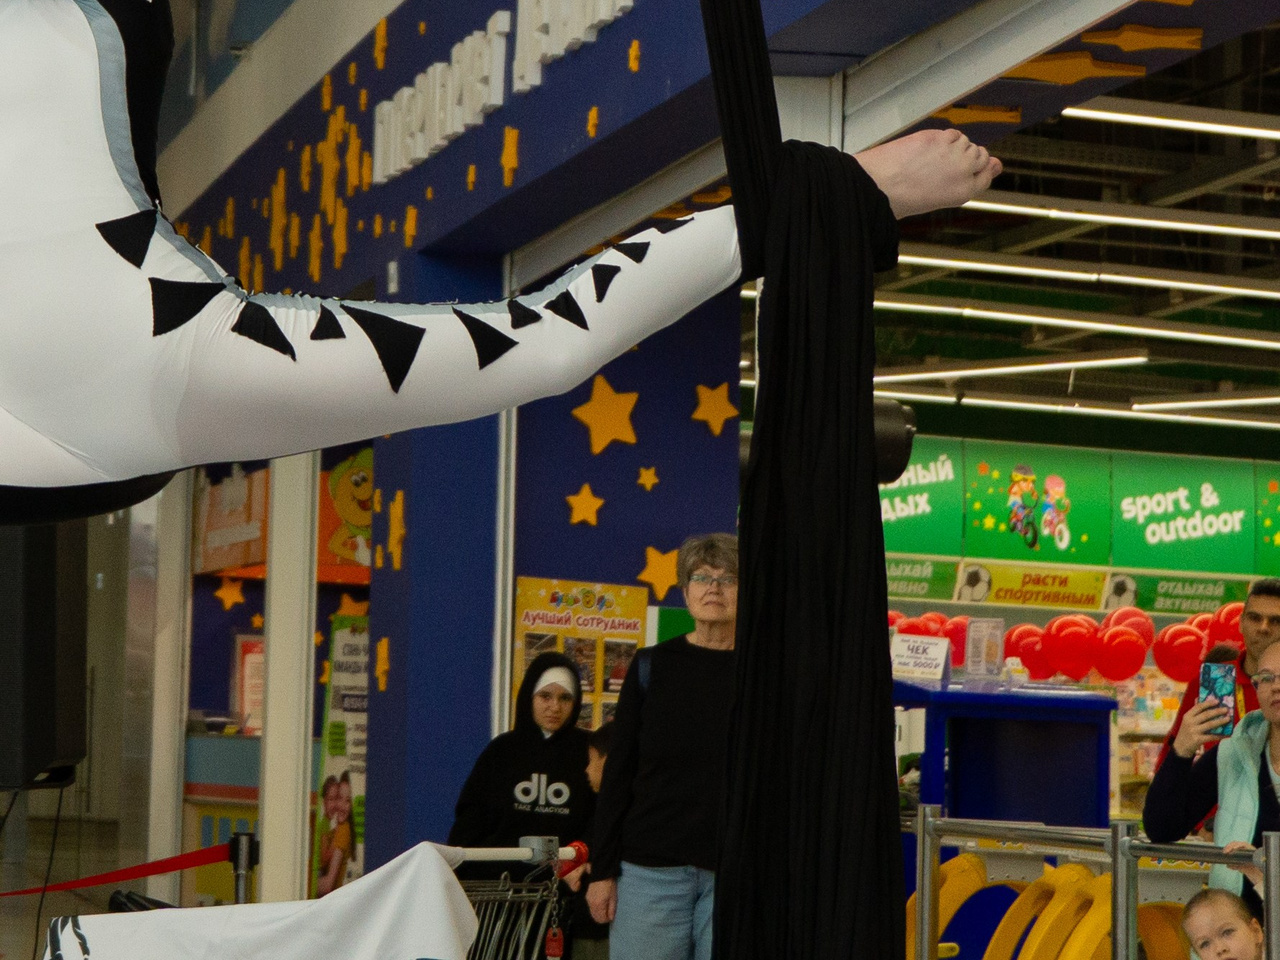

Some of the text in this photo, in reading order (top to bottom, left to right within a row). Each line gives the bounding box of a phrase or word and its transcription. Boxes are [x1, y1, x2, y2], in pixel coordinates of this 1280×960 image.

[1121, 482, 1219, 524] sport &
[1145, 509, 1245, 546] outdoor
[1022, 572, 1068, 588] расти
[994, 587, 1097, 606] спортивным
[513, 773, 570, 805] dlo
